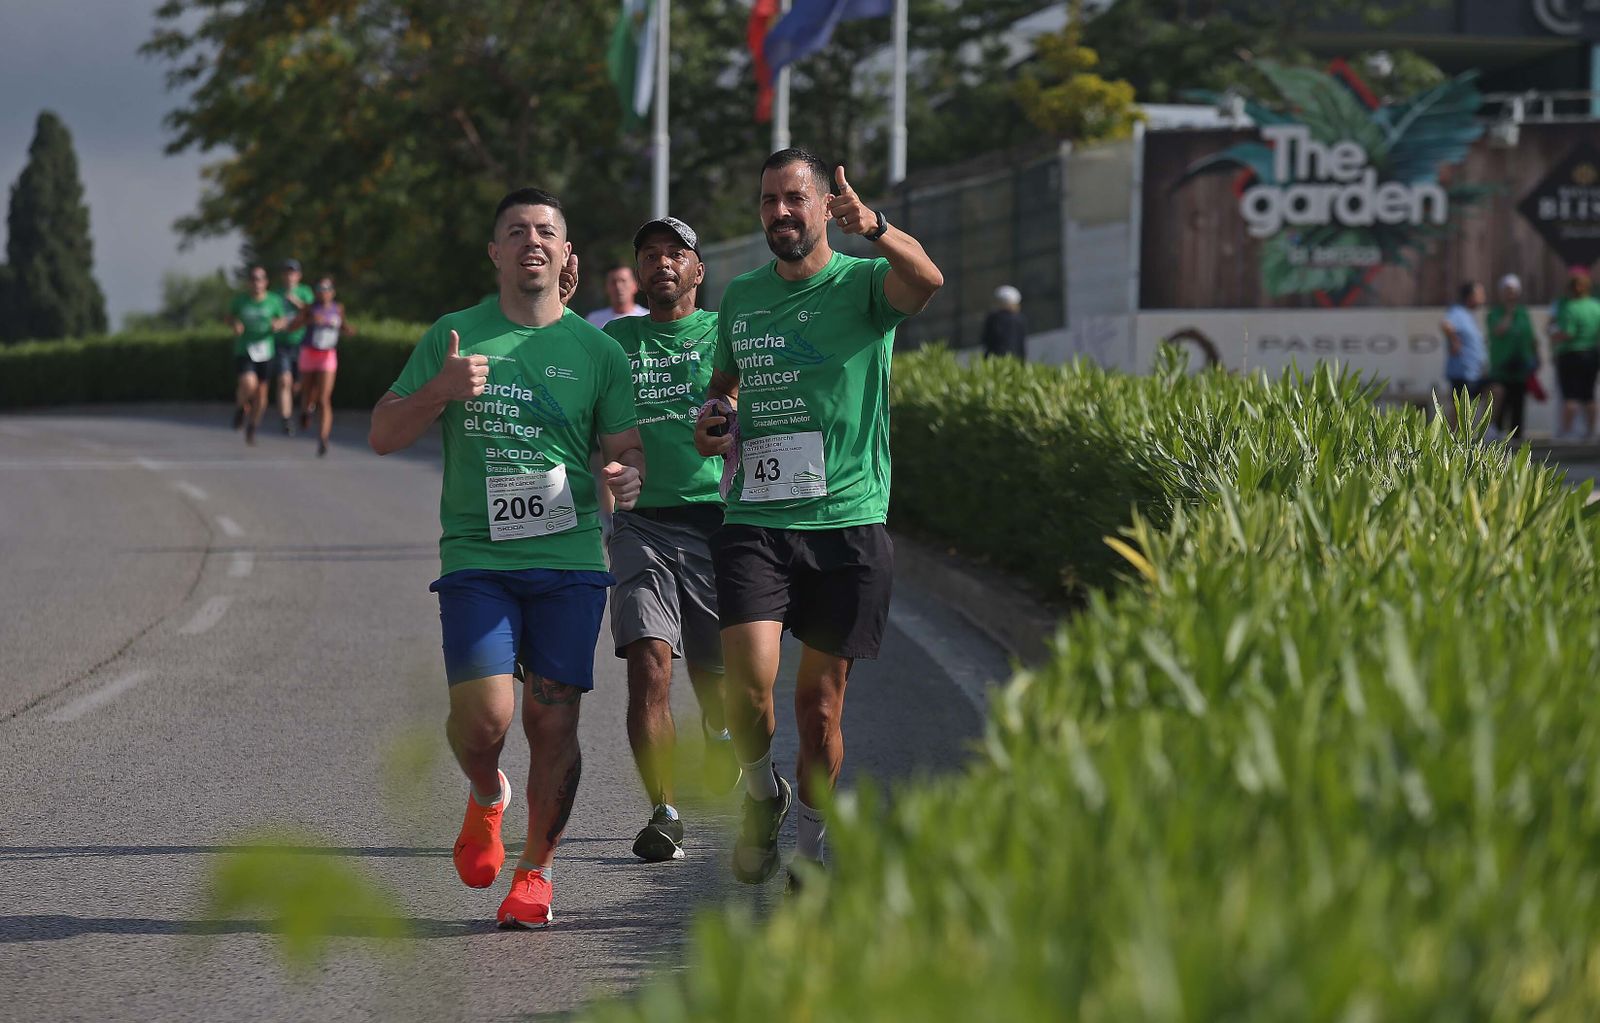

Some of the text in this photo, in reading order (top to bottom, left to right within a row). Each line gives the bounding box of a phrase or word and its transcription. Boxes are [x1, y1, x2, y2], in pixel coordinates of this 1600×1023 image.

[1260, 124, 1367, 184] The
[1239, 168, 1448, 238] garden
[732, 320, 747, 334] En
[732, 333, 786, 352] marcha
[1258, 333, 1398, 355] PASEO
[643, 350, 701, 368] marcha
[632, 369, 672, 384] ontra
[748, 370, 801, 387] cáncer
[482, 383, 533, 401] archa
[638, 382, 693, 399] cáncer
[464, 399, 520, 418] contra
[751, 397, 806, 413] SKODA
[464, 415, 480, 430] el
[482, 417, 543, 439] cáncer
[636, 413, 687, 425] razalema Motor
[753, 416, 811, 427] Grazalema Motor
[485, 447, 545, 461] SKODA
[486, 465, 526, 474] Grazalema
[754, 457, 781, 483] 43
[492, 494, 545, 522] 206
[496, 524, 525, 532] SKODA
